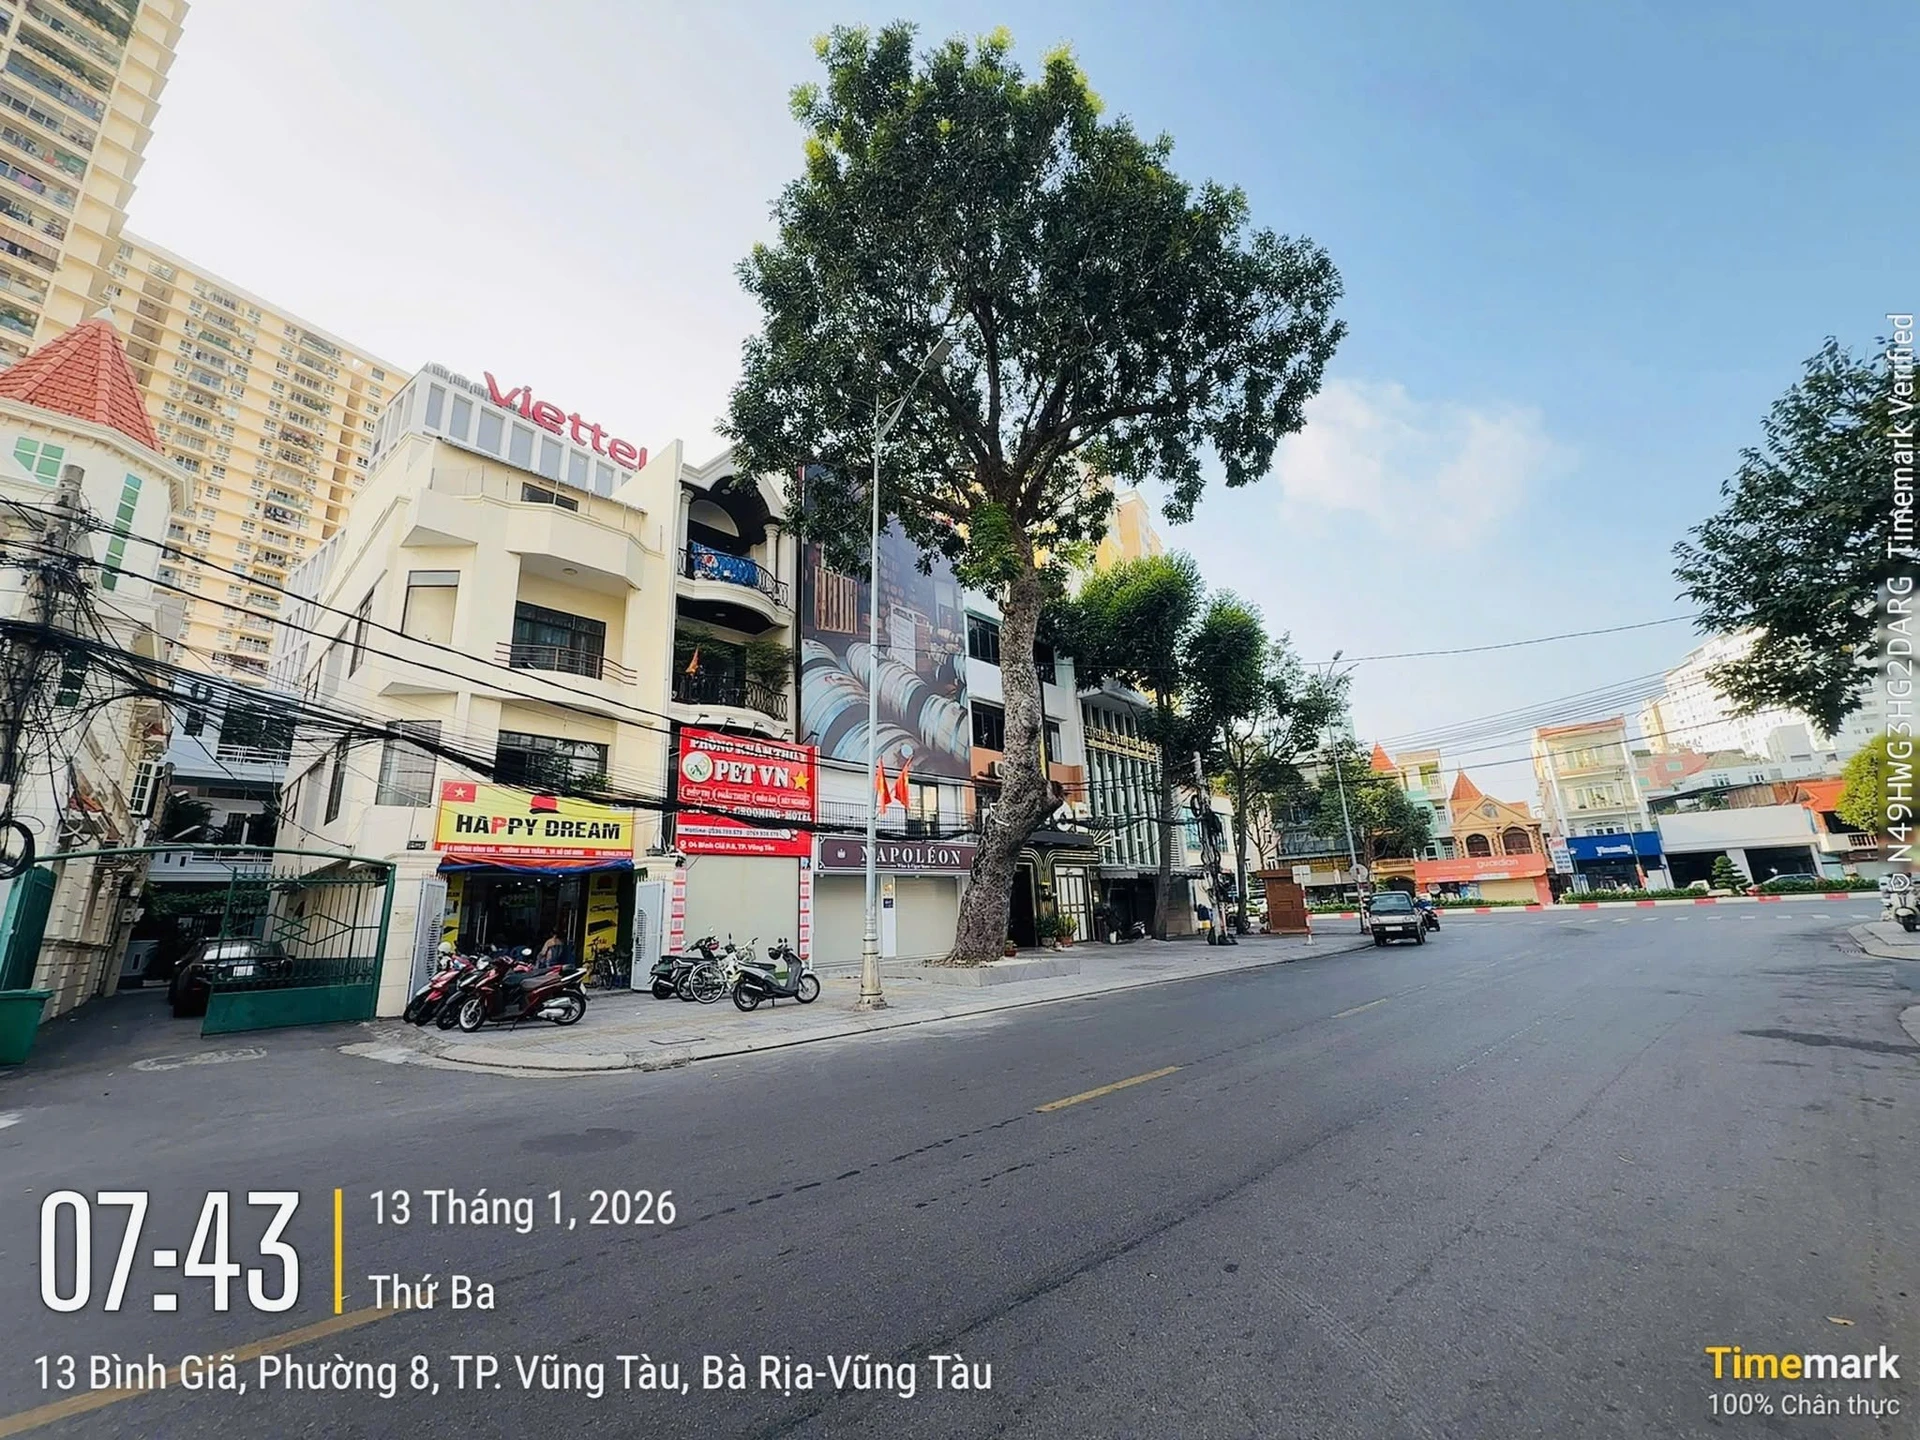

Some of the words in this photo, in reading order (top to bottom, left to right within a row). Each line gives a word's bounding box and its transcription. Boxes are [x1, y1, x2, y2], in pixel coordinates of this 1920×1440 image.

[713, 760, 756, 784] PET
[757, 765, 790, 788] VN
[456, 814, 538, 837] HAPPY
[545, 820, 621, 840] DREAM
